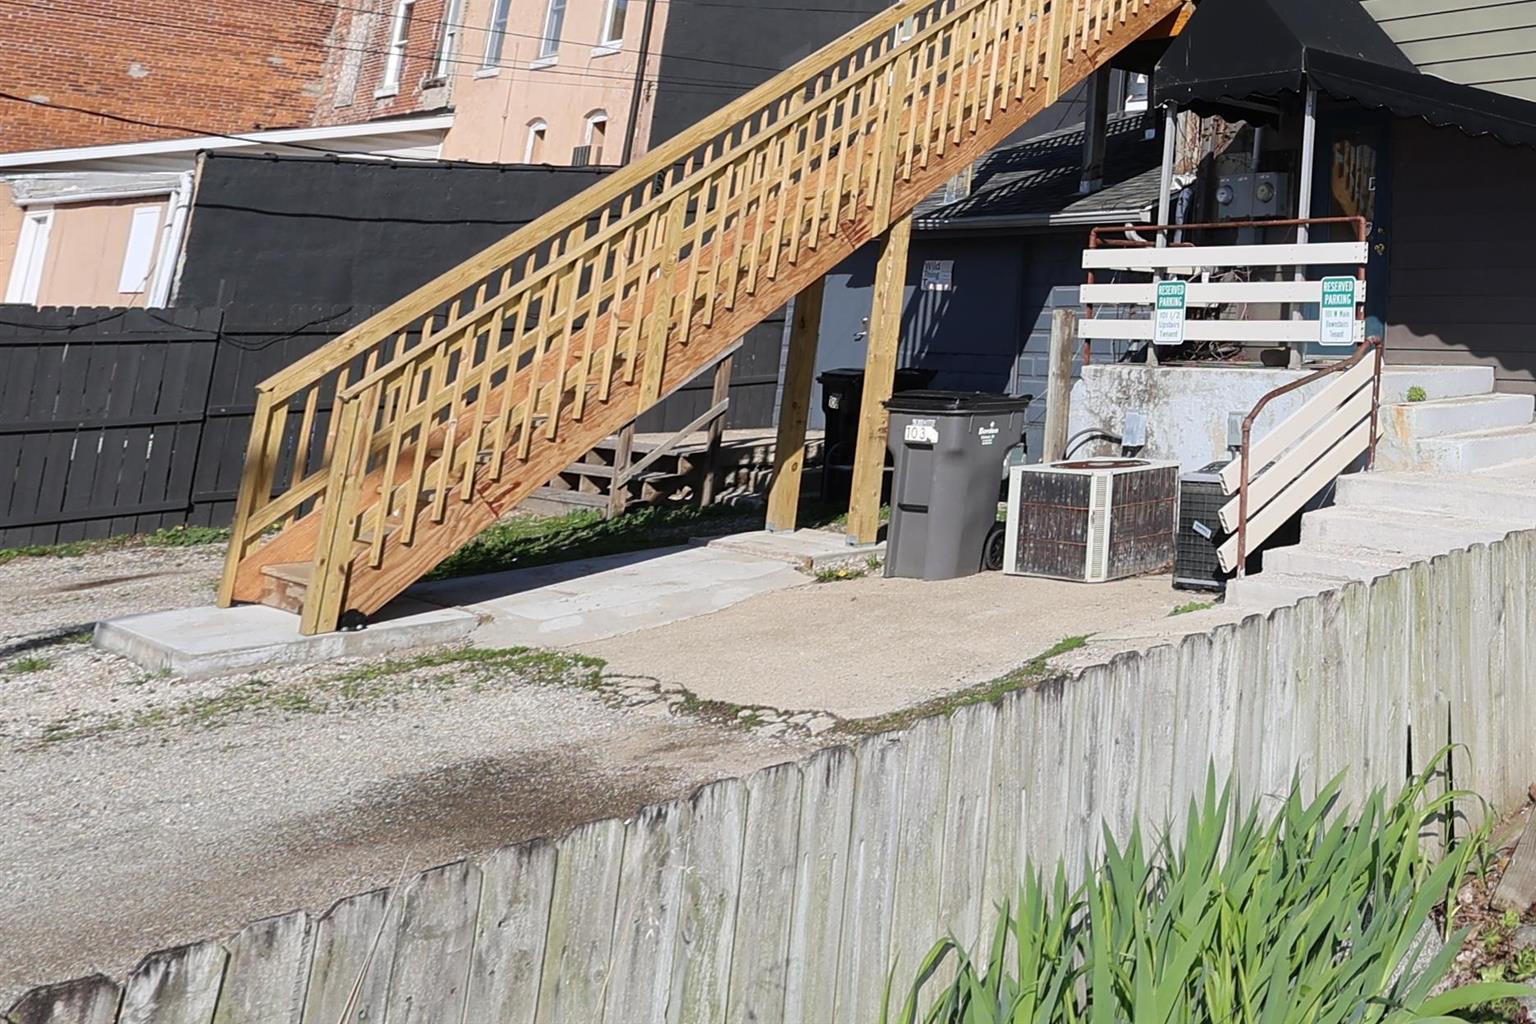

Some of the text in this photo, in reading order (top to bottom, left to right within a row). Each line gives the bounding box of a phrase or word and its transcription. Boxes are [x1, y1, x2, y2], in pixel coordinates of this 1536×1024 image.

[1158, 284, 1185, 295] RESERVED
[1324, 281, 1353, 292] RESERVED
[1158, 296, 1184, 307] PARKING
[1324, 293, 1351, 305] PARKING
